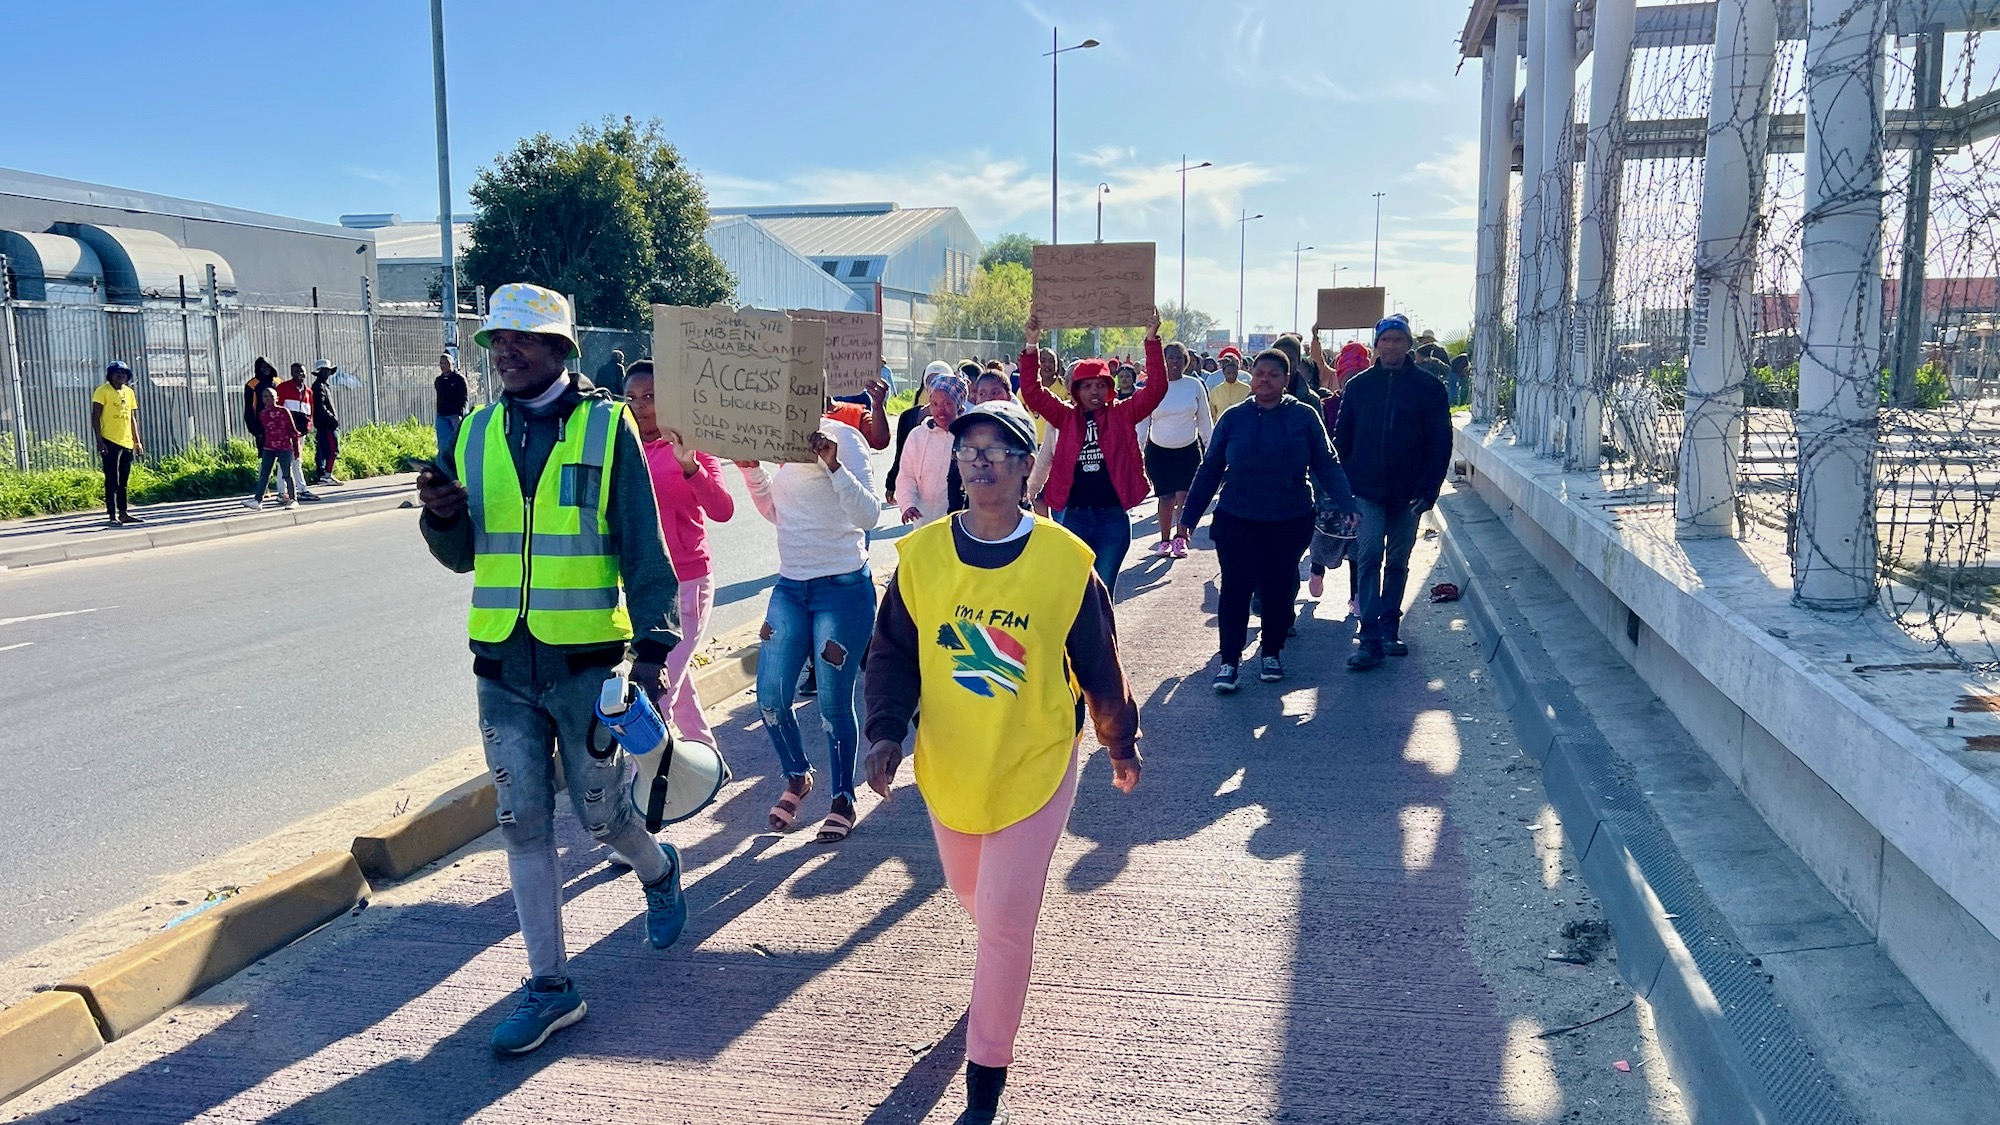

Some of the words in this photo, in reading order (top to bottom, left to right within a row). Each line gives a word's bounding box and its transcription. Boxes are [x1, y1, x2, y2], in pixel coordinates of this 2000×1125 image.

[1035, 287, 1063, 302] NO
[762, 340, 807, 357] CAMP
[695, 356, 782, 394] ACCESS
[693, 388, 708, 404] IS
[785, 404, 809, 422] BY
[692, 409, 731, 430] SOLD
[736, 421, 783, 440] WASTE
[695, 427, 727, 442] ONE
[731, 434, 758, 450] SAY
[954, 604, 974, 620] I'M
[975, 609, 984, 621] A
[988, 608, 1030, 631] FAN
